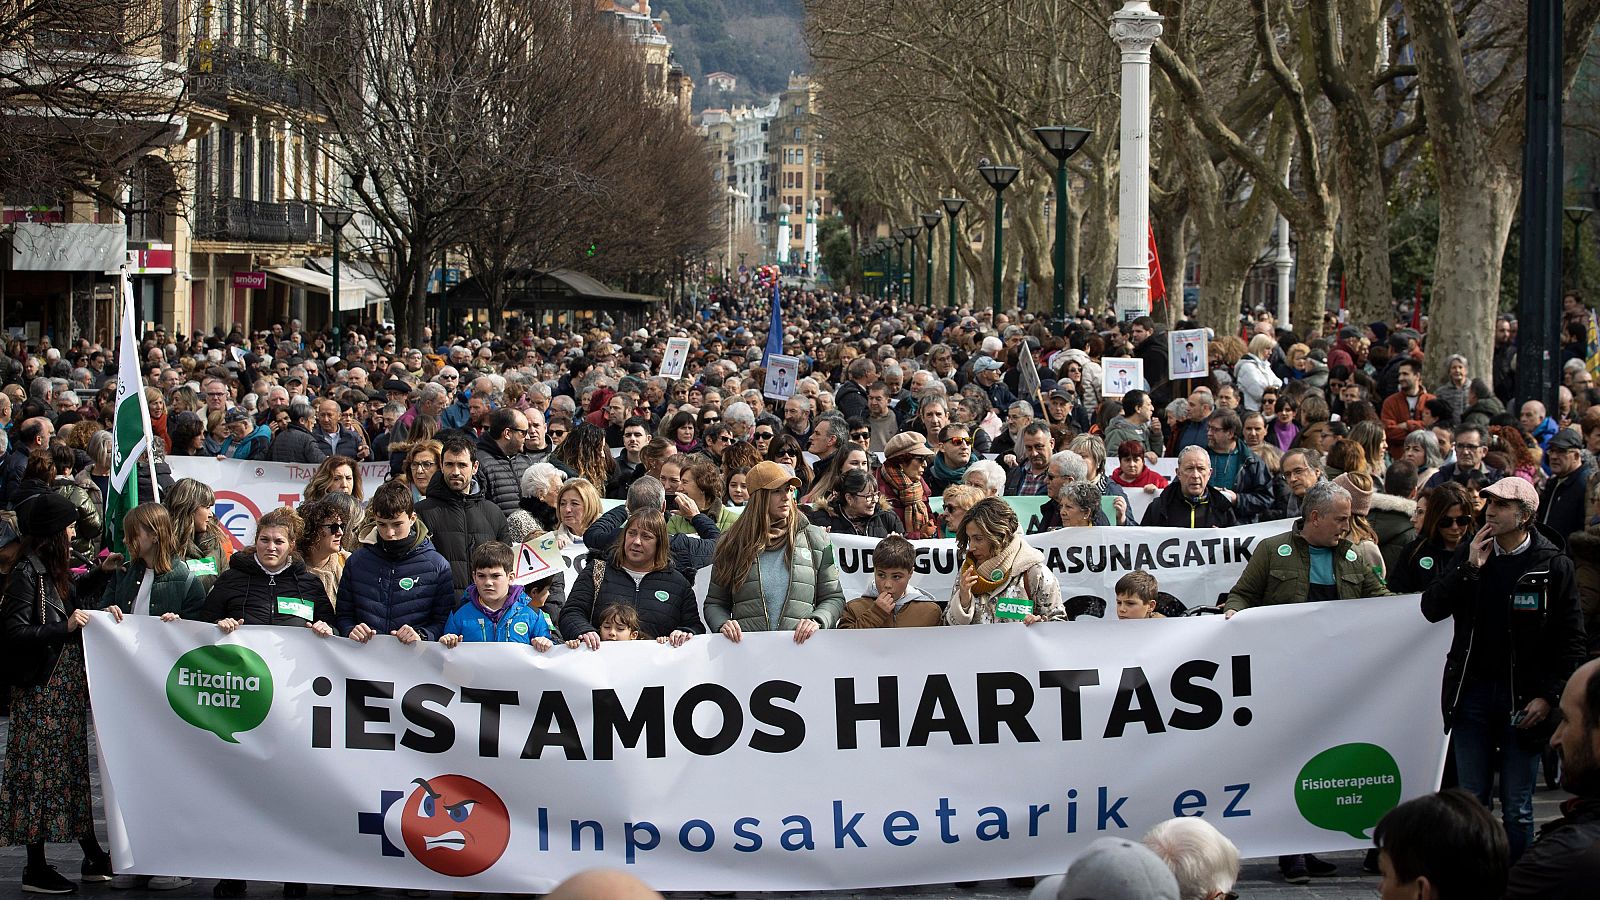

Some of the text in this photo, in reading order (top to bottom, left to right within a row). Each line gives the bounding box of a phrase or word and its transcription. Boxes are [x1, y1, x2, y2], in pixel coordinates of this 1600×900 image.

[235, 275, 262, 286] smöoy
[1032, 536, 1255, 574] ASUNAGATIK
[997, 602, 1032, 615] SATSE
[1514, 595, 1535, 605] ELA
[178, 667, 260, 691] Erizaina
[197, 690, 241, 709] naiz
[834, 655, 1254, 750] HARTAS!
[1301, 774, 1395, 790] Fisioterapeuta
[1336, 793, 1363, 806] naiz
[537, 783, 1252, 865] Inposaketarik ez
